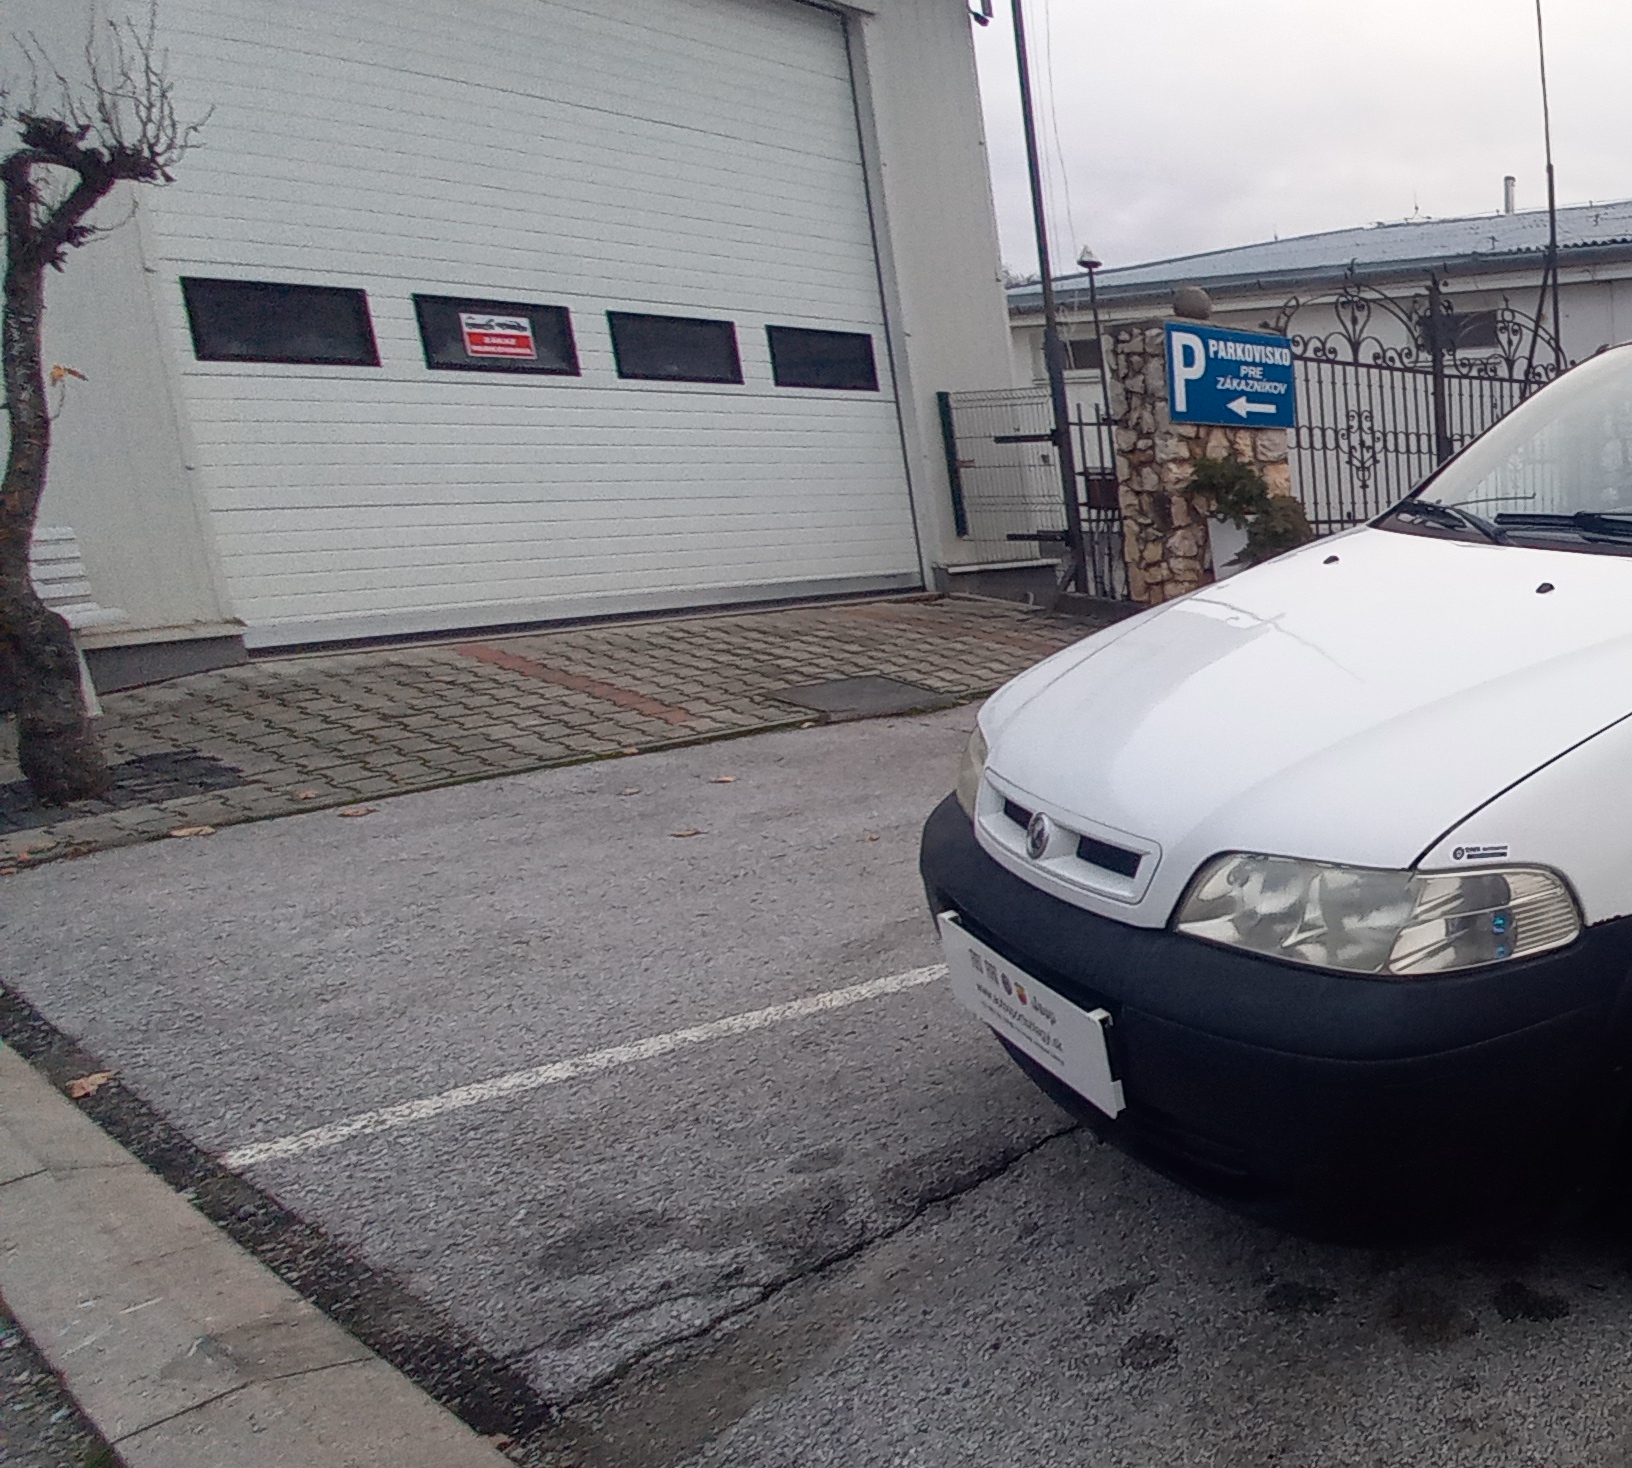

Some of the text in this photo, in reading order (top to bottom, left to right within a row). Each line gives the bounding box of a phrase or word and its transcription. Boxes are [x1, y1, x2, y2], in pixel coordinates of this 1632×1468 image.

[1208, 339, 1291, 366] PARKOVISKO
[1171, 331, 1206, 412] P
[1240, 365, 1263, 379] PRE
